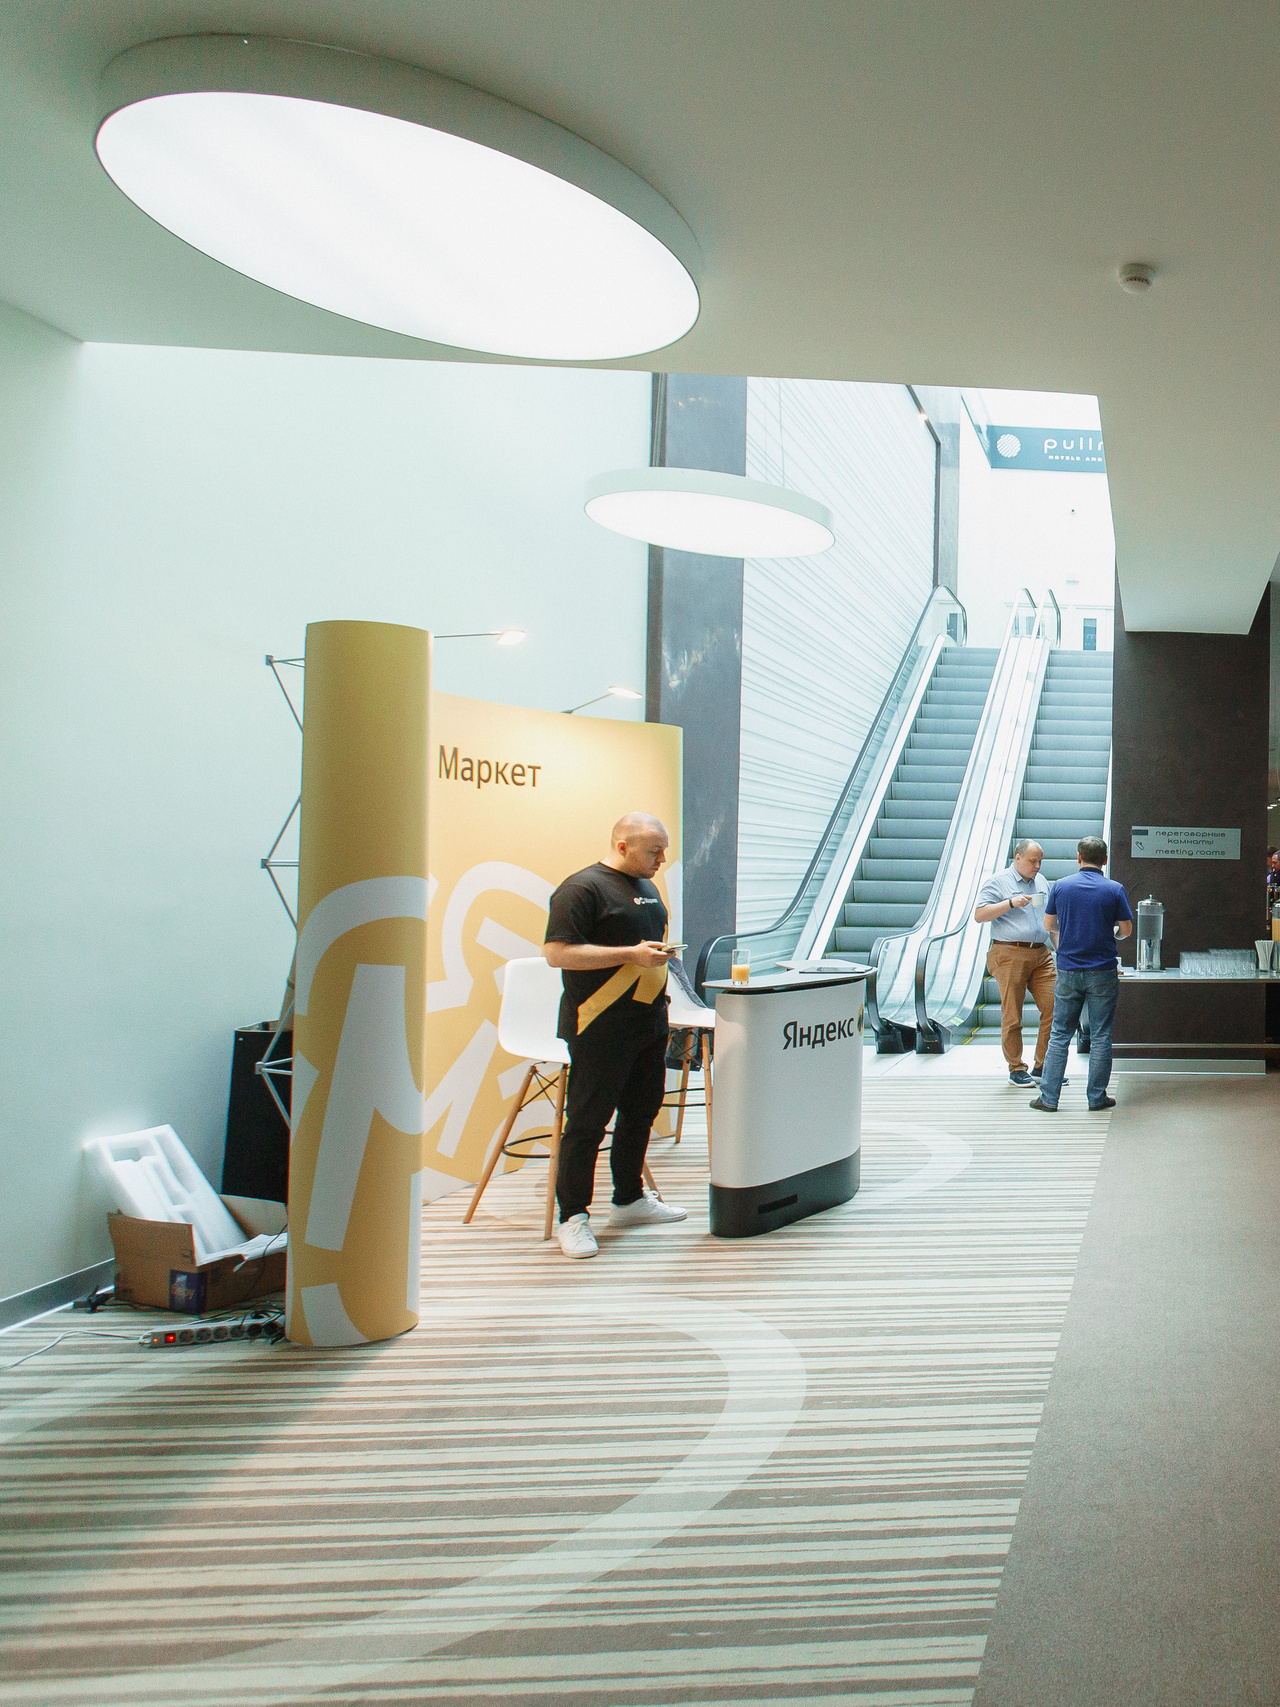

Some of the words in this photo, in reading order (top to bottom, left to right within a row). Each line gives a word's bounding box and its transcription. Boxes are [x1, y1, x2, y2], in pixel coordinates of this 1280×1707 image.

[438, 744, 542, 790] Маркет
[1155, 830, 1226, 838] переговорные
[1155, 848, 1194, 856] meeting
[782, 1017, 854, 1050] Яндекс
